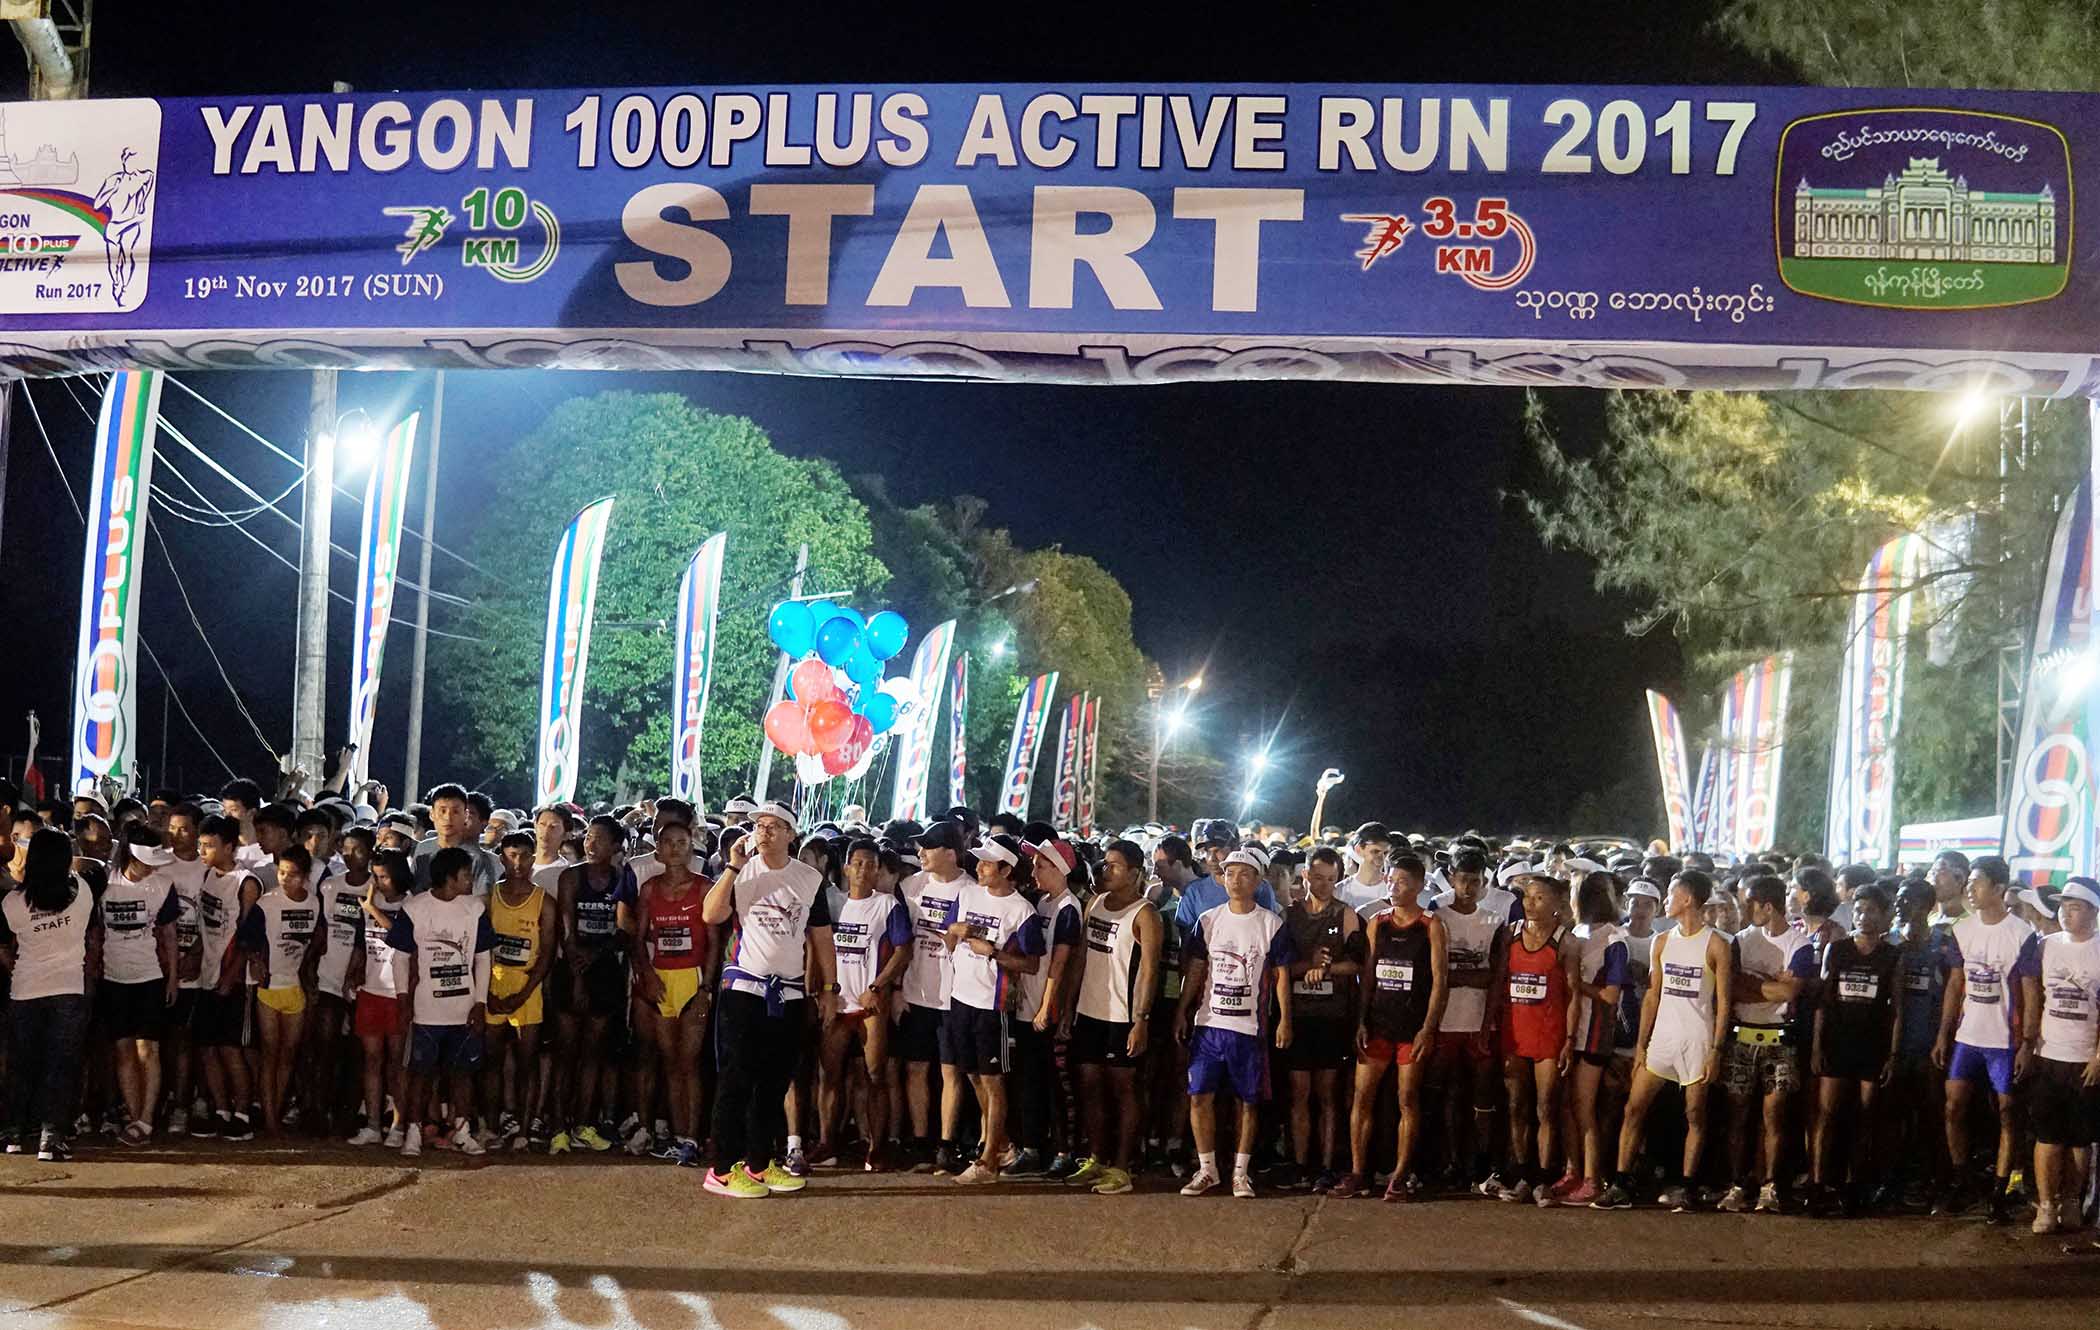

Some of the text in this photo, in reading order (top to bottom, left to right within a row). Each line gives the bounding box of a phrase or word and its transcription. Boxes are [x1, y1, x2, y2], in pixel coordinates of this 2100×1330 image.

[201, 94, 1757, 176] YANGON 100PLUS ACTIVE RUN 2017
[462, 187, 525, 229] 10
[1423, 199, 1507, 237] 3.5
[464, 239, 517, 266] KM
[614, 182, 1304, 312] START
[1437, 247, 1492, 272] KM
[36, 284, 102, 299] Run 2017
[236, 277, 287, 297] Nov
[296, 277, 354, 298] 2017
[364, 275, 444, 300] (SUN)
[34, 916, 71, 932] STAFF
[1220, 997, 1242, 1006] 2013
